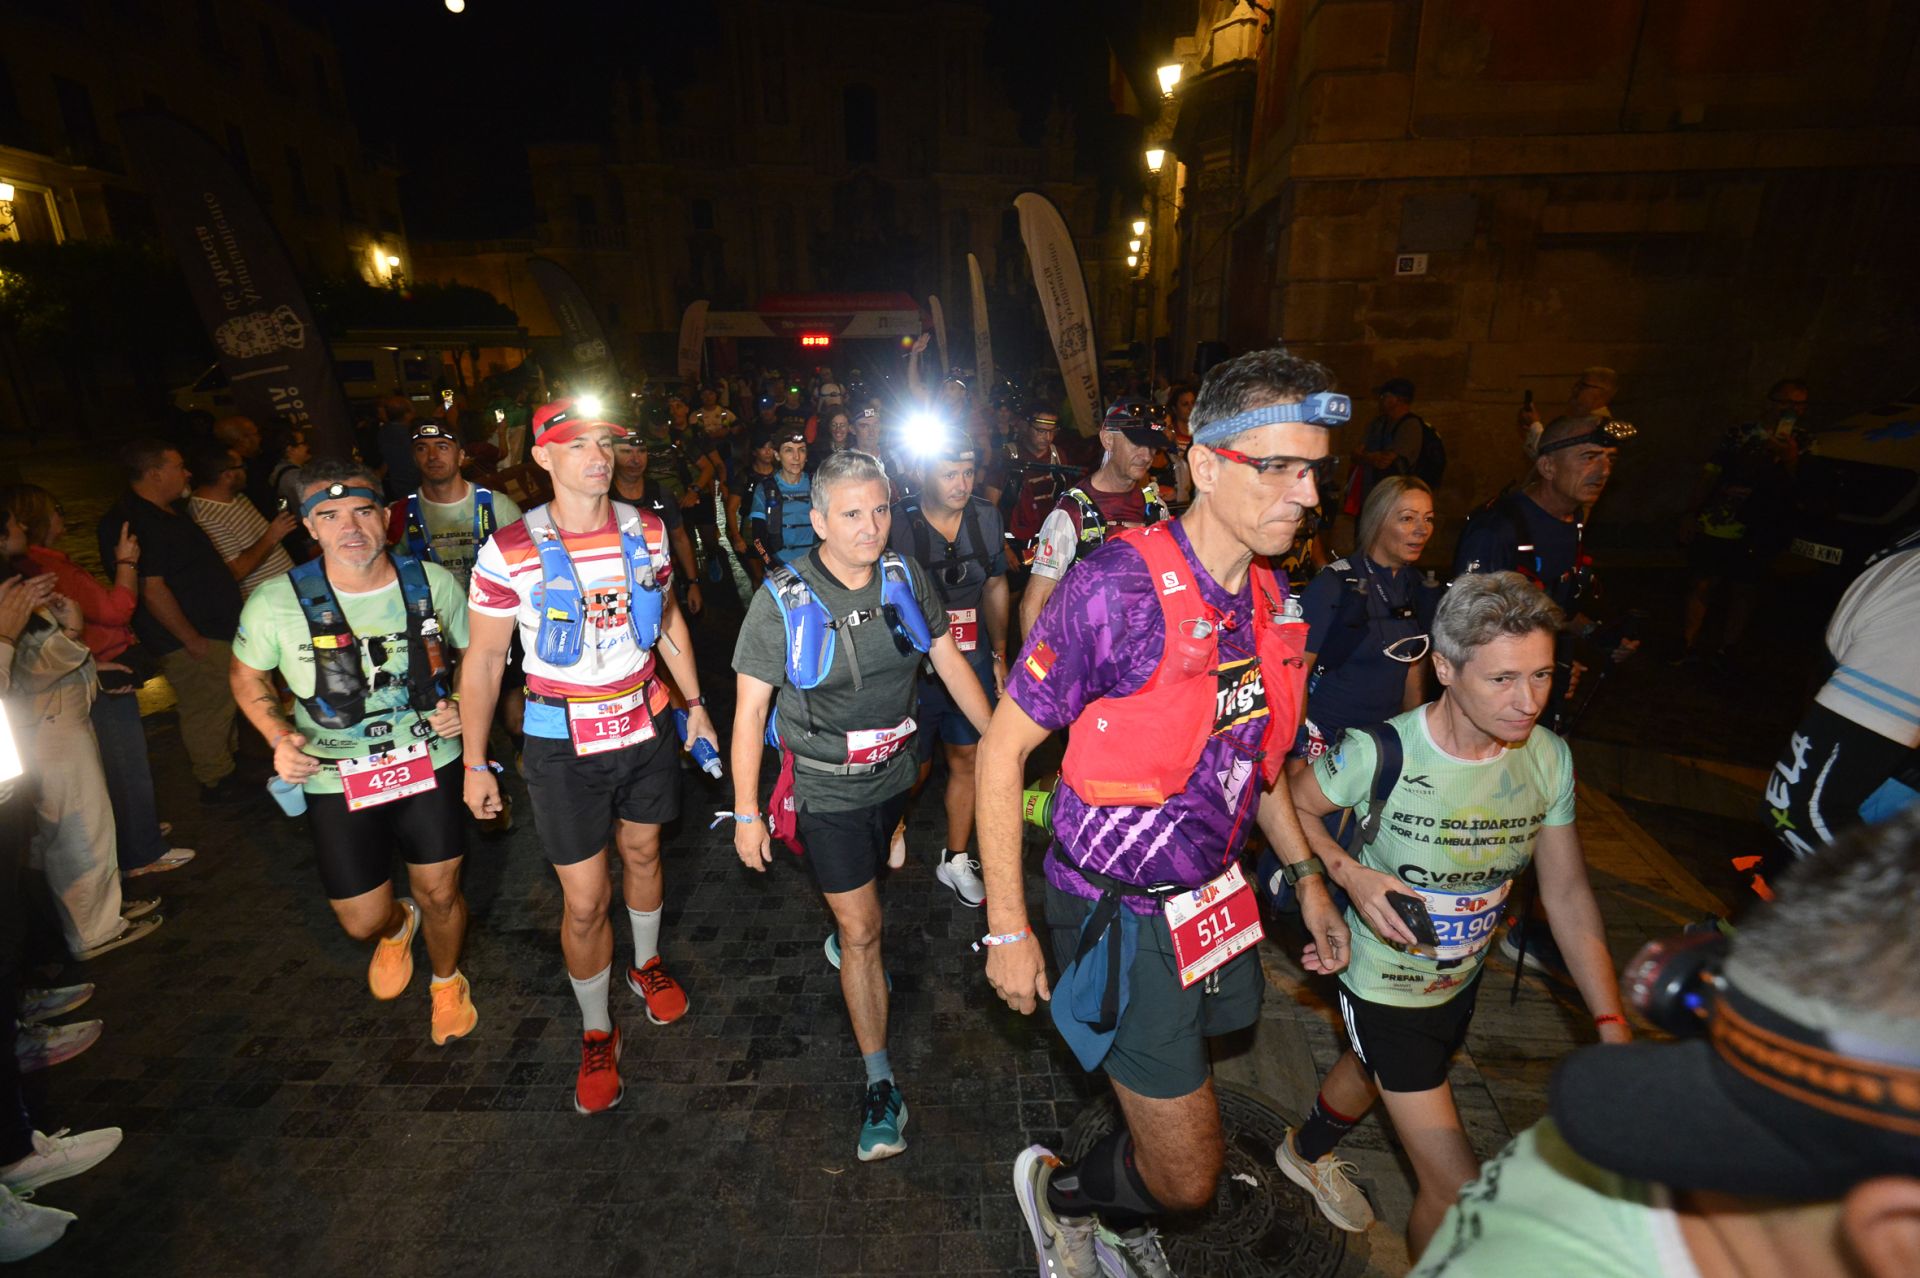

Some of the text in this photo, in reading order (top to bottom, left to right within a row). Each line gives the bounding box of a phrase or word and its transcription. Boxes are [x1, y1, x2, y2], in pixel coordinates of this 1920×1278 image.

[594, 716, 631, 737] 132
[866, 742, 900, 762] 424
[367, 766, 412, 790] 423
[1391, 811, 1547, 831] RETO SOLIDARIO 90
[1390, 823, 1526, 847] POR LA AMBULANCIA DEL
[1196, 905, 1237, 948] 511
[1433, 911, 1497, 942] 2190
